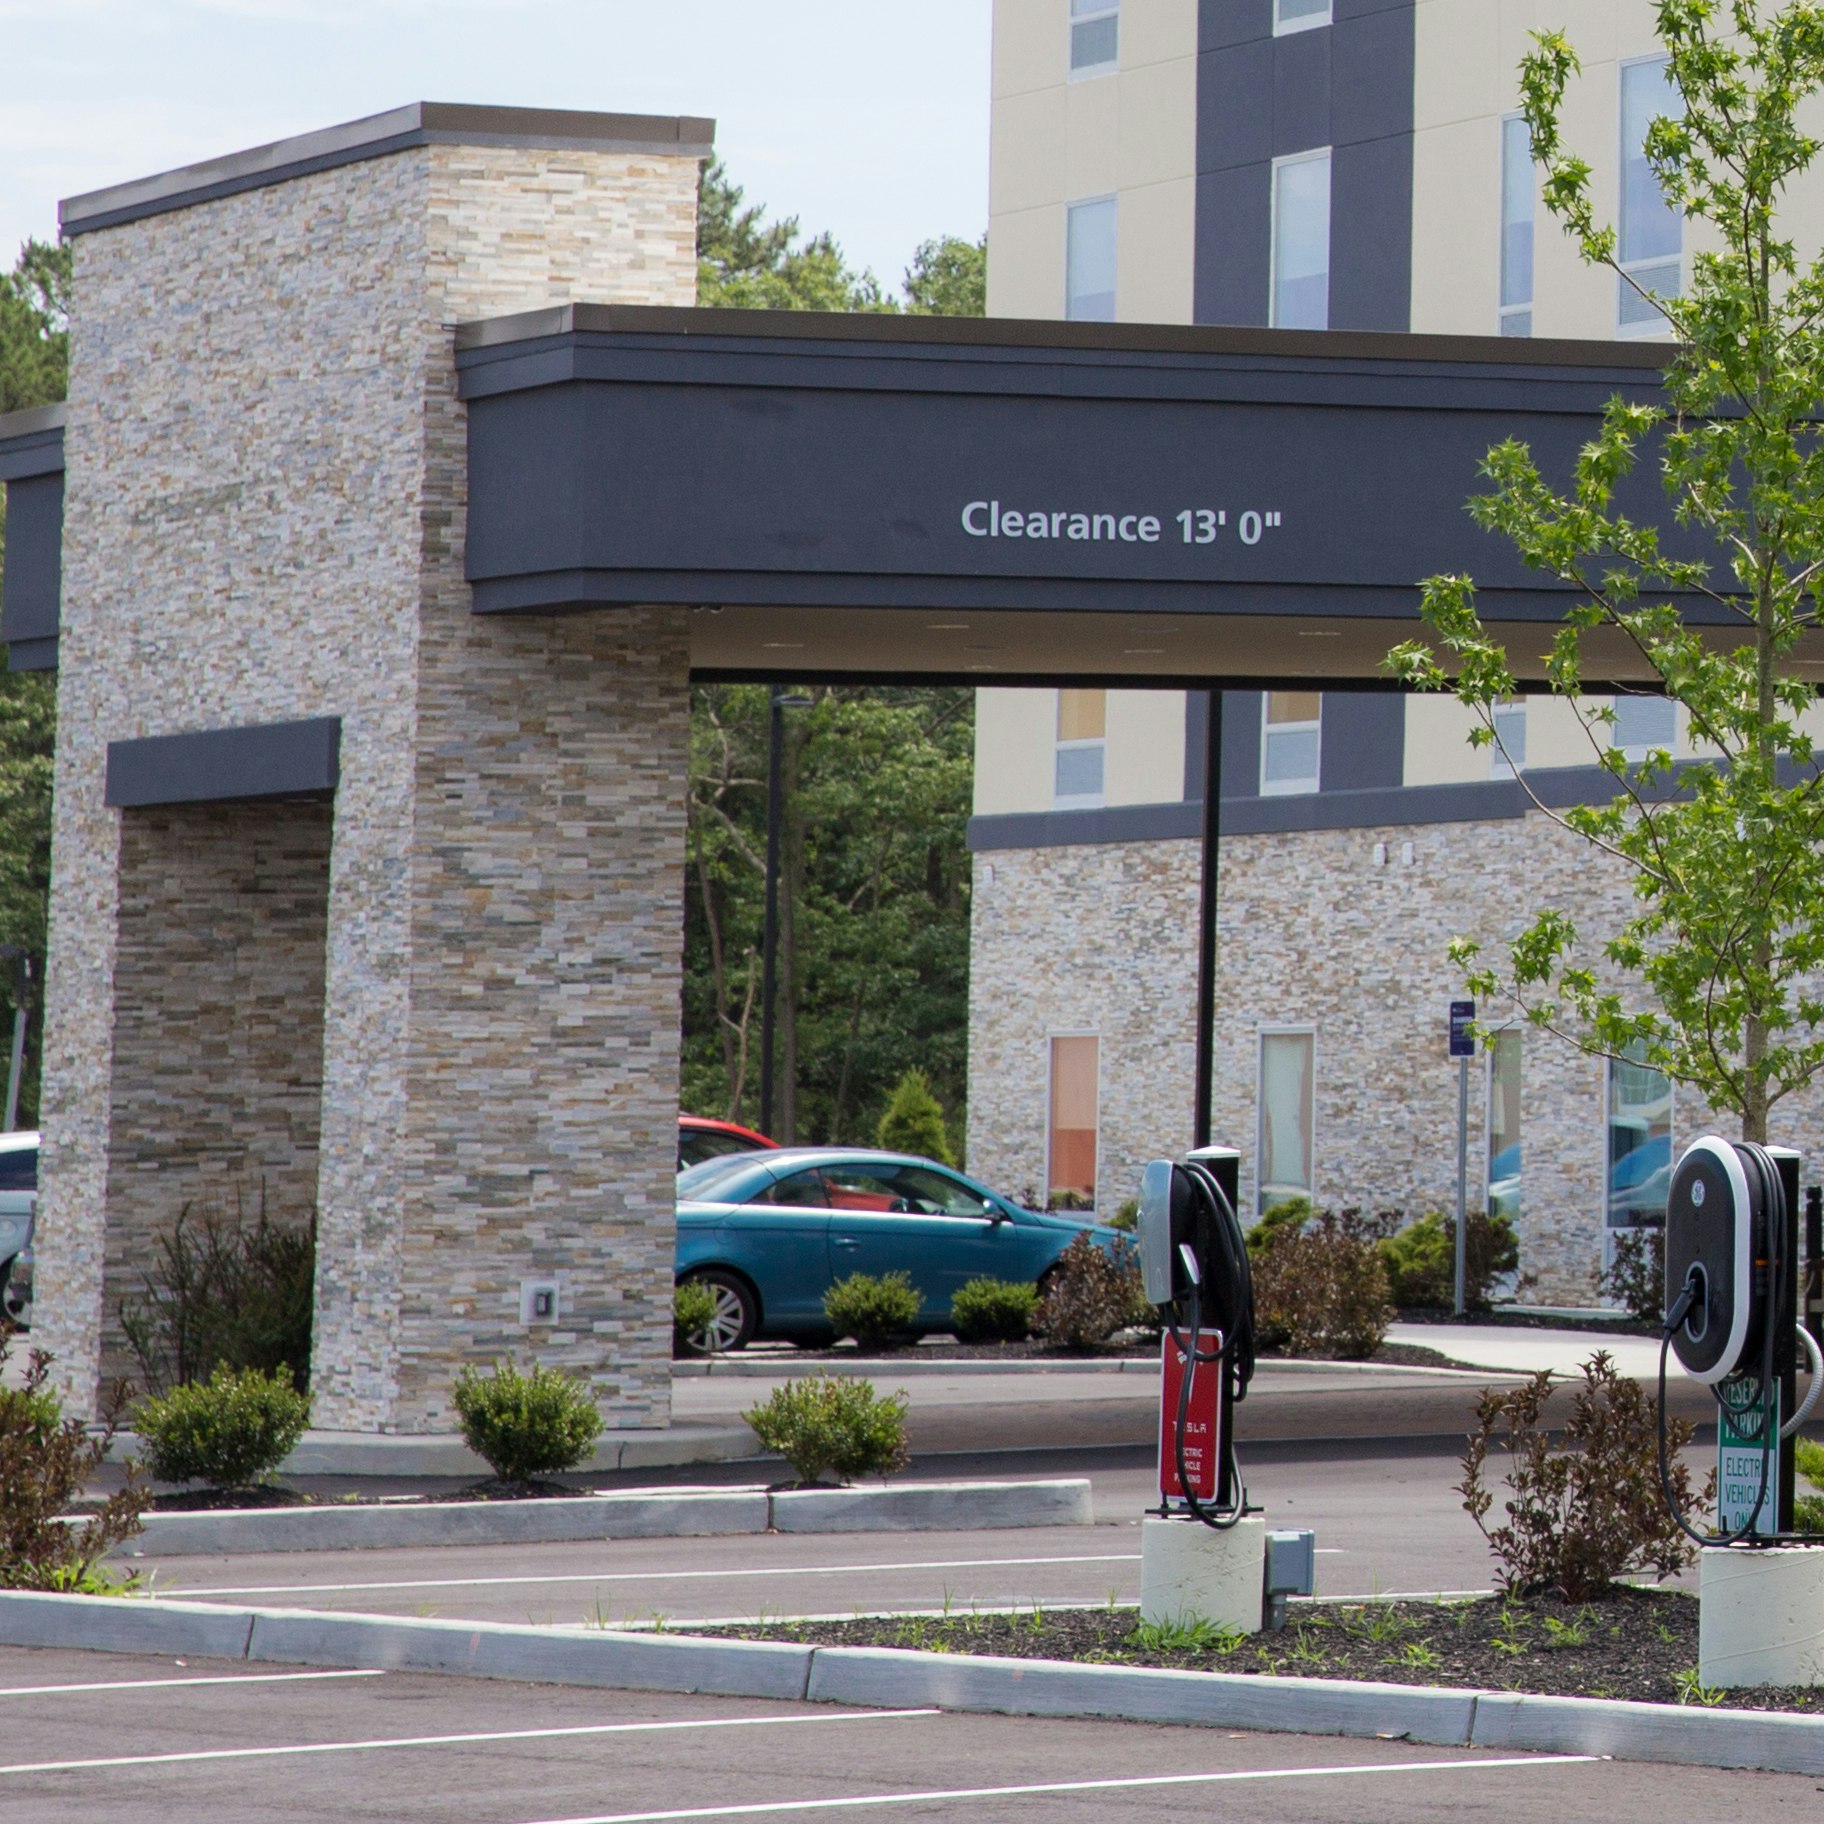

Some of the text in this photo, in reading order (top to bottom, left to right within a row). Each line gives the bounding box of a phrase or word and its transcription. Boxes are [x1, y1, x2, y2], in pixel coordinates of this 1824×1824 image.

[961, 500, 1282, 545] Clearance 13' 0"
[1172, 1421, 1207, 1434] TSLA
[1726, 1457, 1763, 1478] ELECTR
[1725, 1483, 1770, 1505] VEHICLS
[1735, 1511, 1751, 1530] ON
